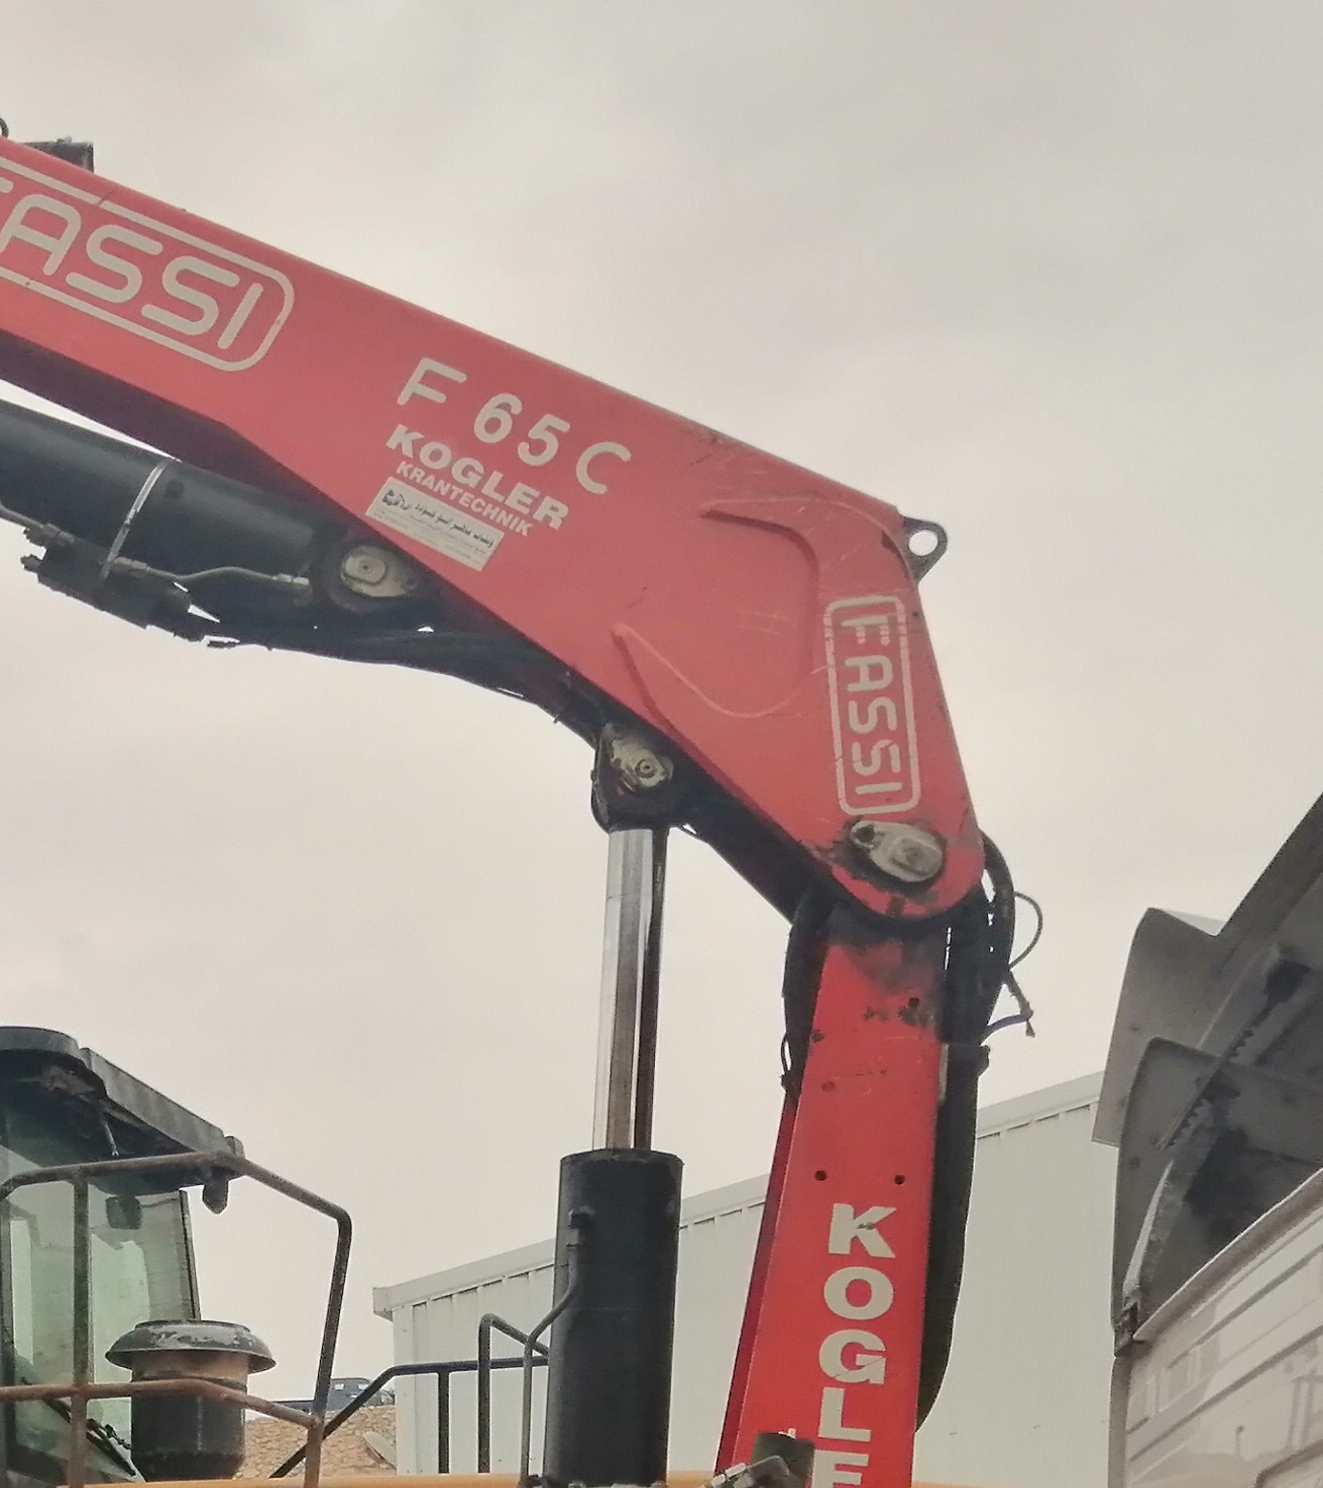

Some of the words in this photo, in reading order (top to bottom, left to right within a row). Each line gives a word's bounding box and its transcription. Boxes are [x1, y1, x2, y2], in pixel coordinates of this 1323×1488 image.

[385, 424, 570, 530] KOGLER
[397, 357, 467, 405] F
[576, 441, 632, 495] C
[396, 460, 533, 537] KRANTECHNIK
[840, 615, 903, 795] FASSI
